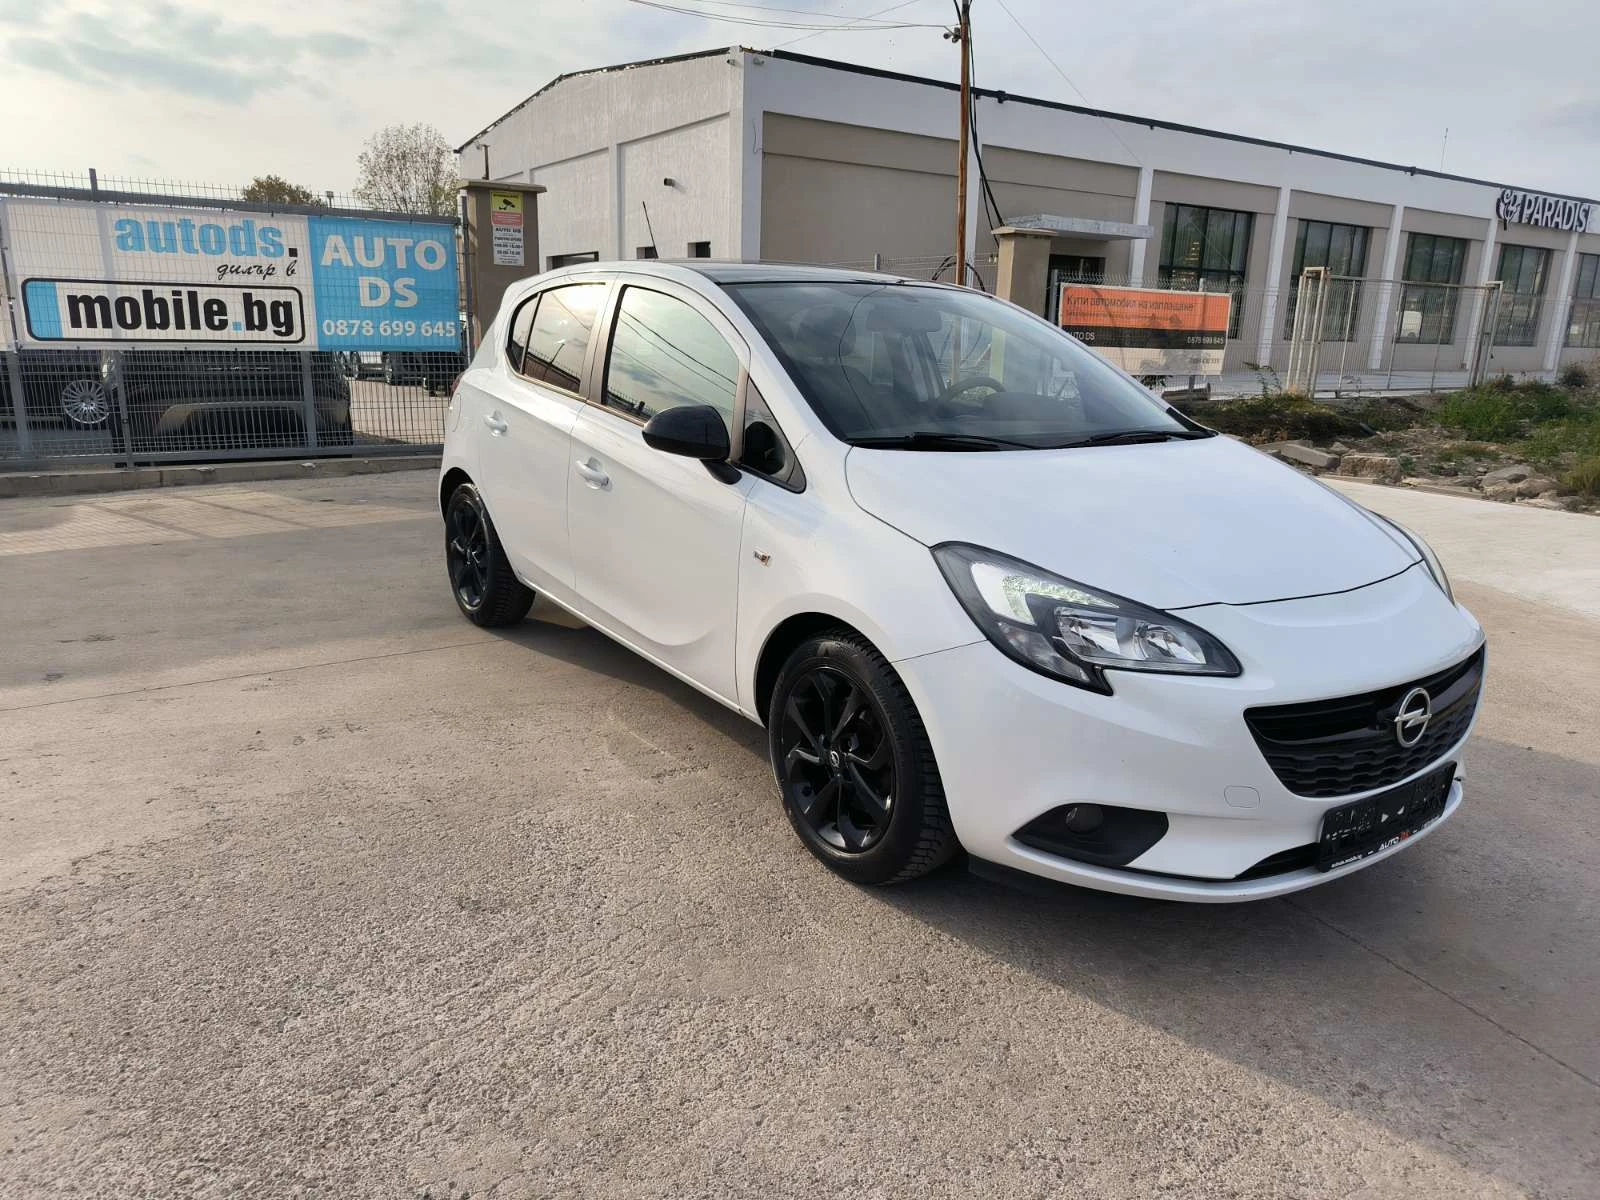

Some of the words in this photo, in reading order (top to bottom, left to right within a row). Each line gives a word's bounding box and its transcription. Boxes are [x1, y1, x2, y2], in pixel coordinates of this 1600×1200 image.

[320, 234, 447, 270] AUTO
[217, 263, 276, 280] дилър
[286, 260, 297, 276] в
[358, 276, 418, 308] DS
[67, 289, 294, 337] mobile.bg
[322, 319, 374, 336] 0878
[379, 320, 416, 337] 699
[420, 321, 456, 337] 645
[1069, 331, 1085, 340] UTO
